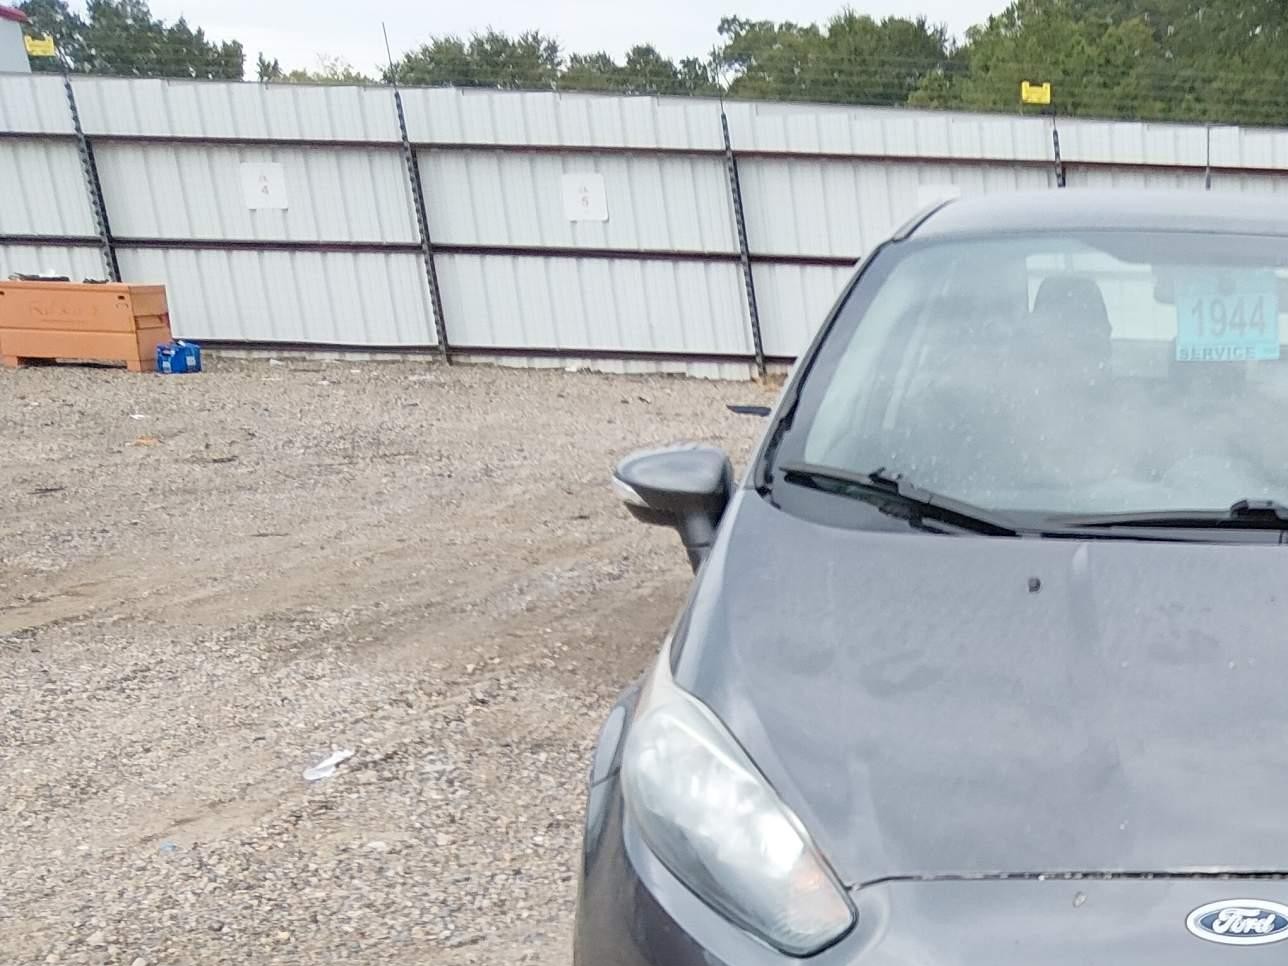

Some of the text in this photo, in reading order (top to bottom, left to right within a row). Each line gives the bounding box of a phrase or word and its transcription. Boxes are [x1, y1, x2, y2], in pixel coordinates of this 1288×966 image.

[1191, 295, 1266, 337] 1944
[1178, 343, 1257, 361] SERVICE
[1211, 906, 1276, 934] Ford
